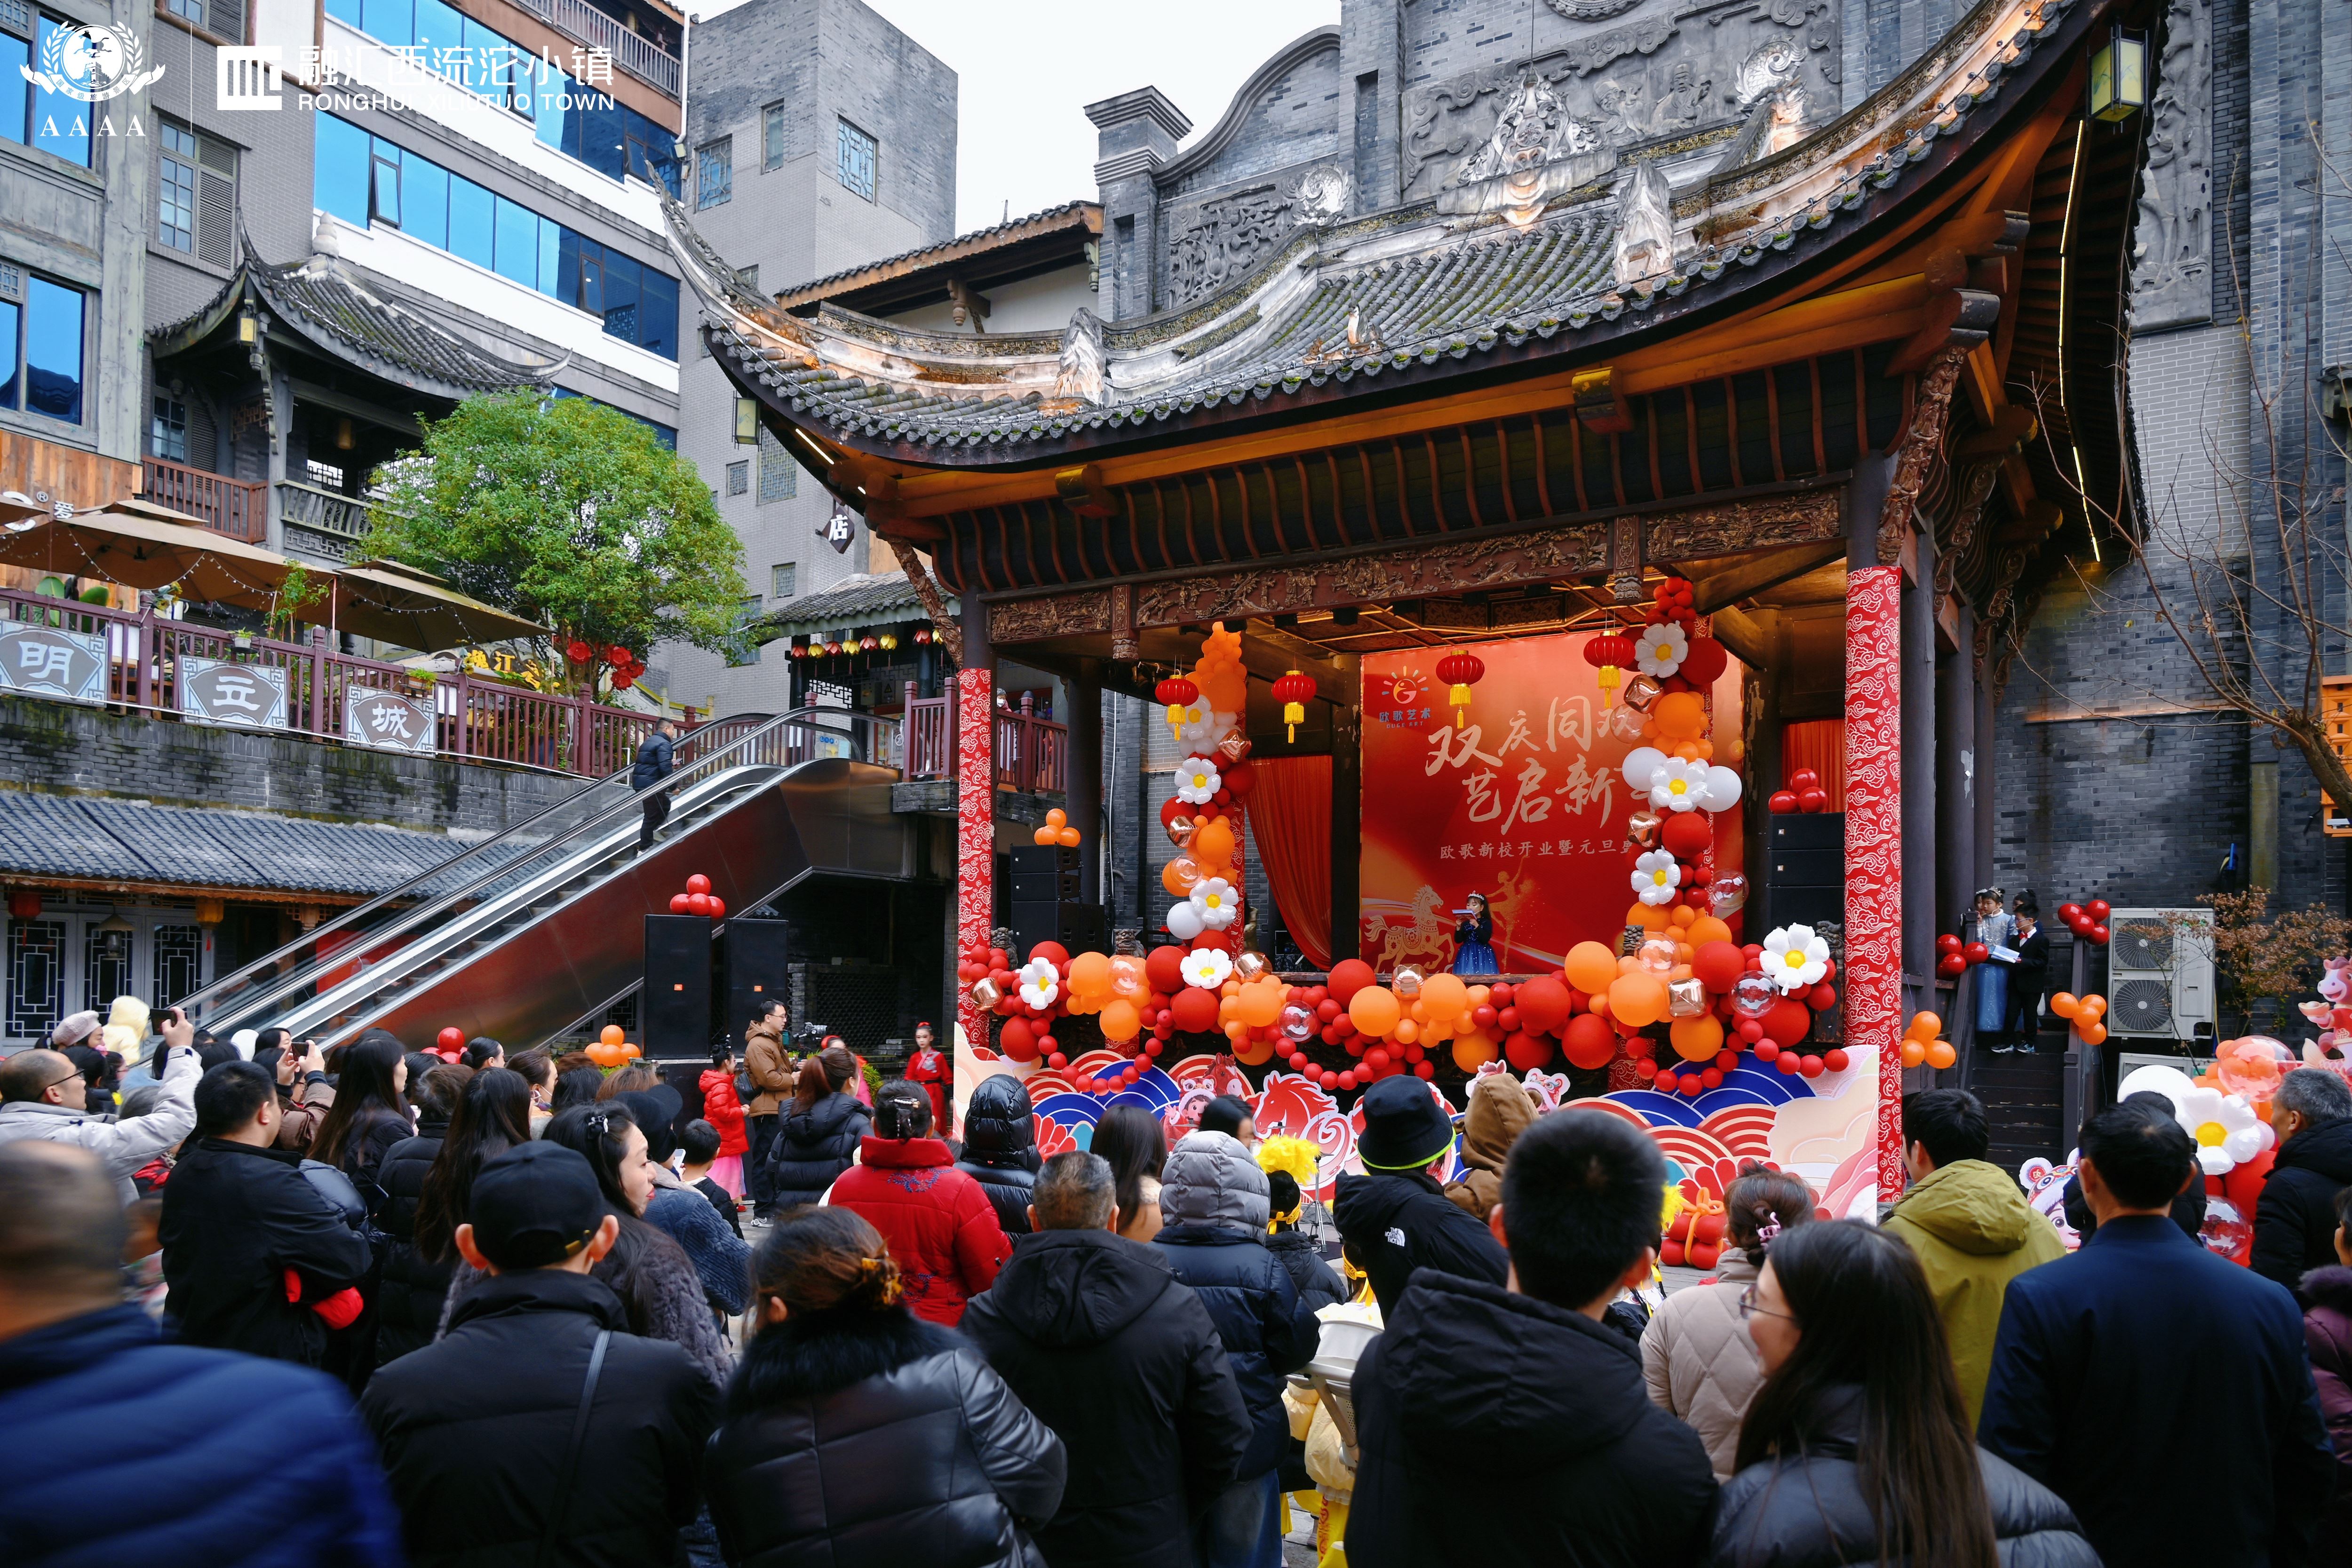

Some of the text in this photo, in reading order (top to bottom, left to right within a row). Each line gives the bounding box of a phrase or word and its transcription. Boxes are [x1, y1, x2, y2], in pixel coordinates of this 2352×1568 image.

[828, 514, 848, 541] 店
[18, 641, 74, 685] 明
[372, 702, 413, 738] 城
[1379, 708, 1430, 723] 欧歌艺术
[1384, 1231, 1398, 1239] NORTH
